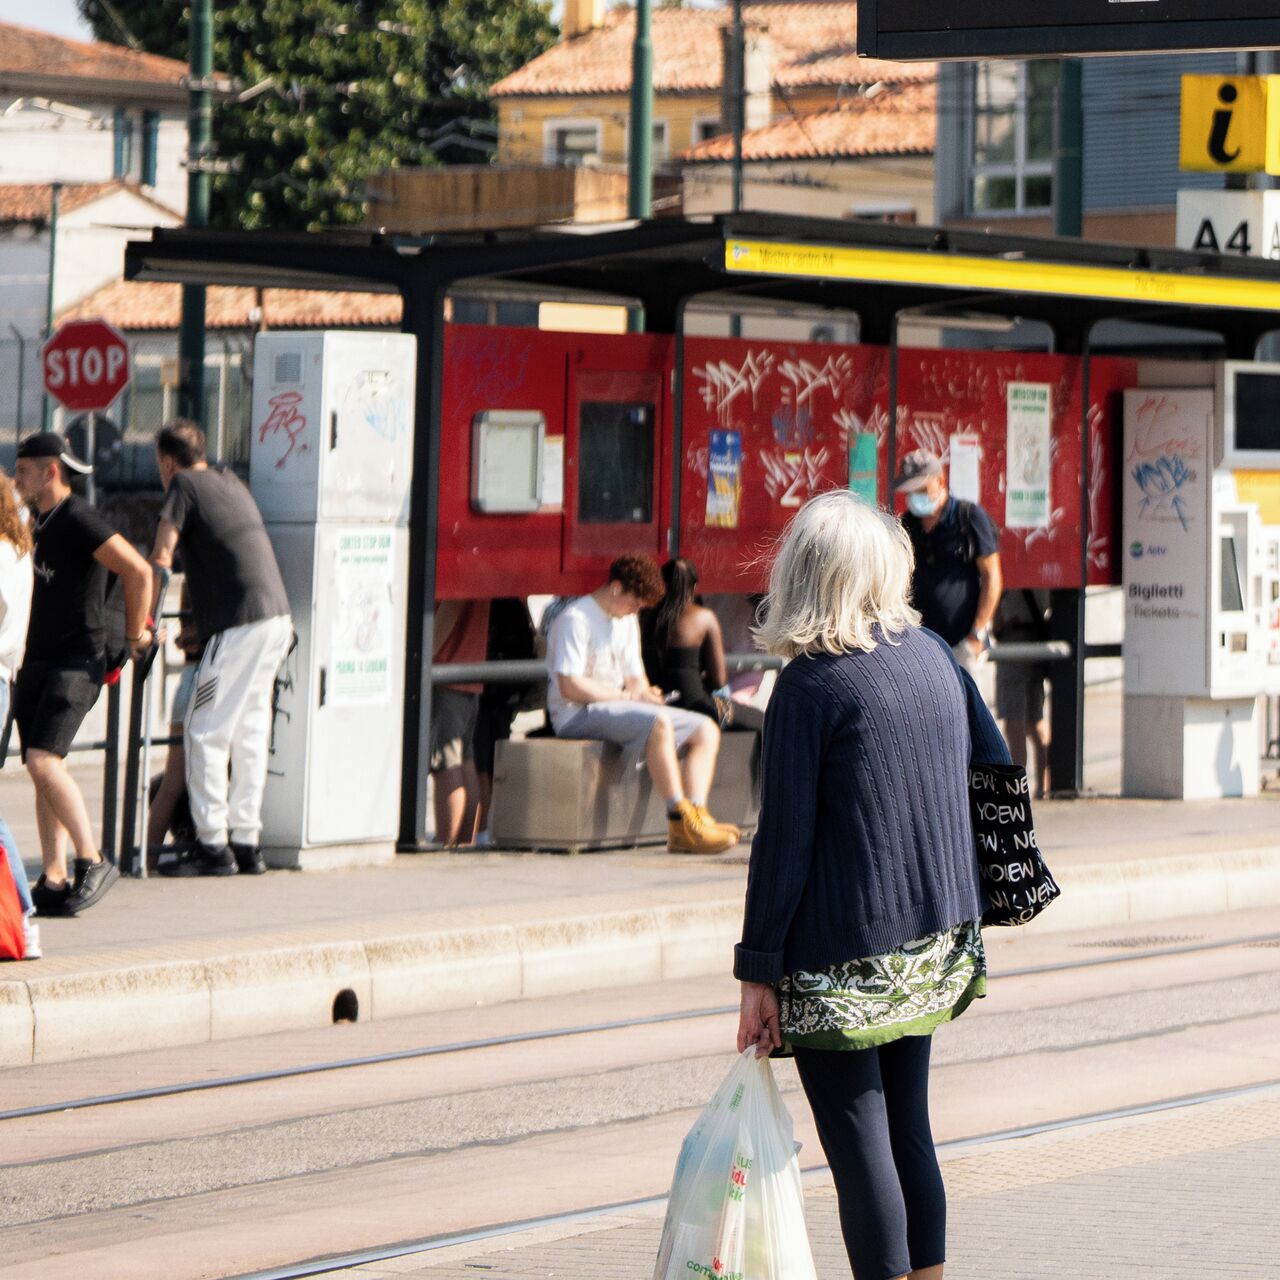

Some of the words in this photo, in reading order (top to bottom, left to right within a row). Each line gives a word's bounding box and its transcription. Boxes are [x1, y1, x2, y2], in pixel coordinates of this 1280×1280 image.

[1192, 217, 1252, 256] A4
[46, 346, 125, 387] STOP
[1129, 583, 1183, 599] Biglietti
[1133, 604, 1180, 619] Tickets
